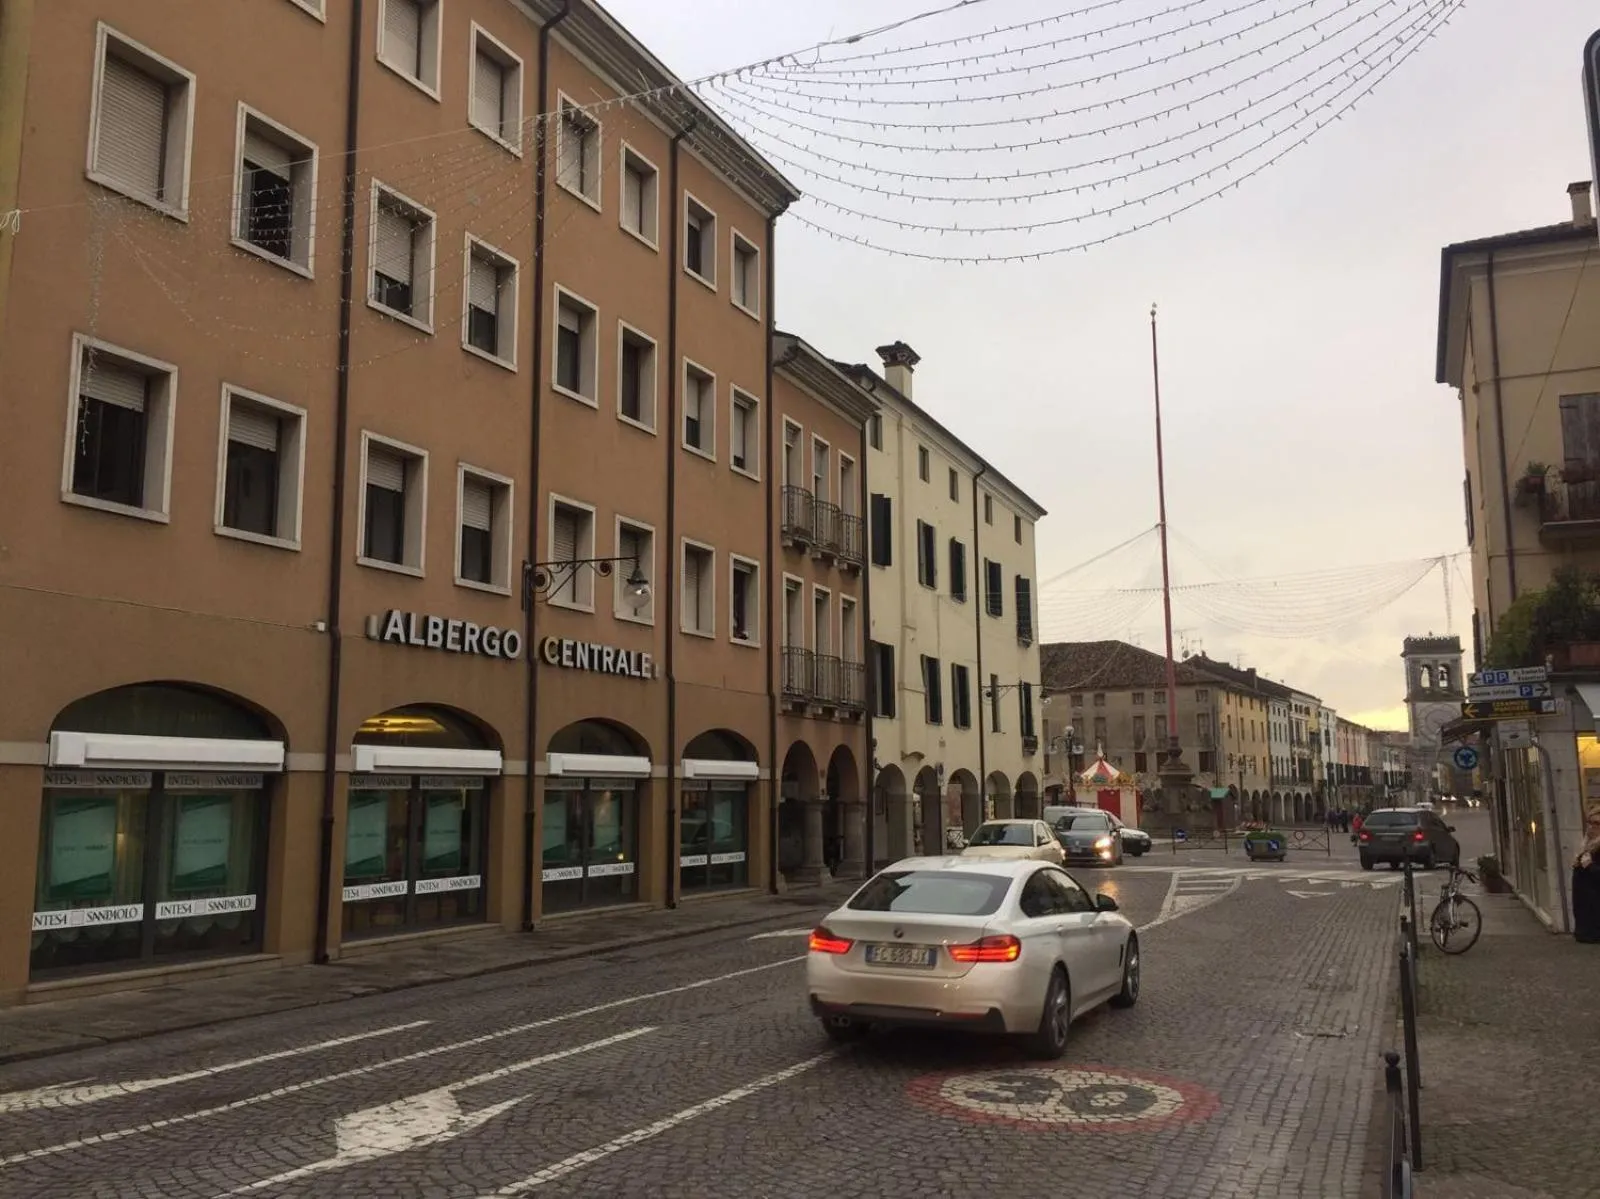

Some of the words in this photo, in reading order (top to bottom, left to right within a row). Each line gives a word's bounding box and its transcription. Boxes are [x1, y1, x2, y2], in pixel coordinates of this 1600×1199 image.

[384, 609, 521, 660] ALBERGO
[543, 636, 653, 679] CENTRALE
[46, 773, 76, 785] NTESA
[160, 904, 192, 916] INTESA
[207, 897, 252, 912] SANPAOLO
[34, 913, 67, 926] NTESA
[86, 907, 138, 923] SANPAOLO
